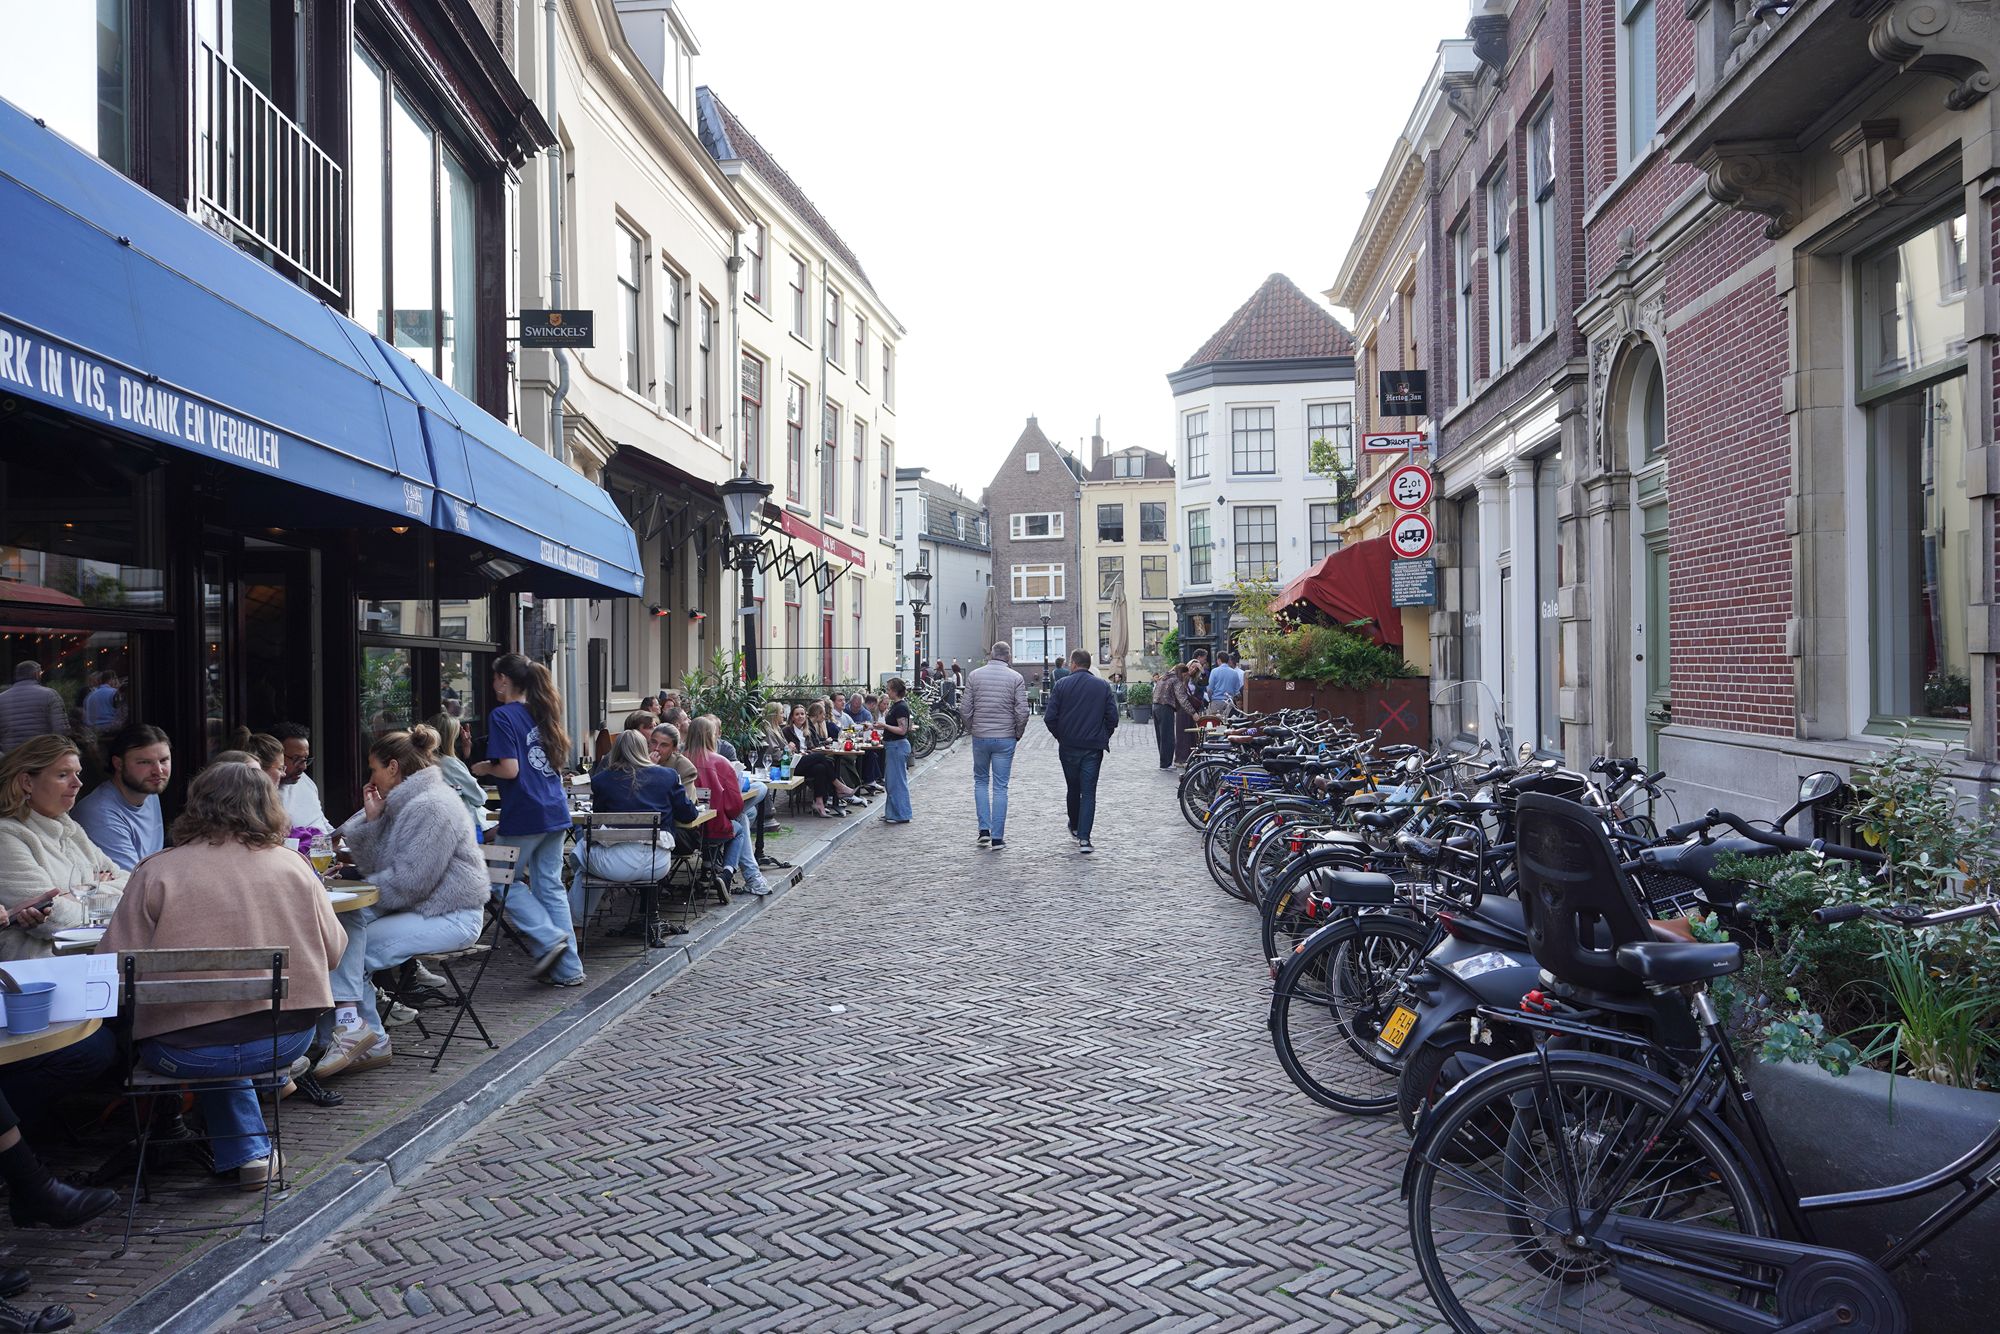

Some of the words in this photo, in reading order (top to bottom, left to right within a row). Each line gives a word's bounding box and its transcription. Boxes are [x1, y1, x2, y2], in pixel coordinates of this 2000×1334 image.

[40, 344, 64, 398] IN
[70, 356, 114, 421] VIS,
[119, 375, 181, 437] DRANK
[184, 400, 205, 446] EN
[208, 409, 280, 470] VERHALEN
[1636, 624, 1642, 634] 4
[1396, 1012, 1415, 1031] FLH
